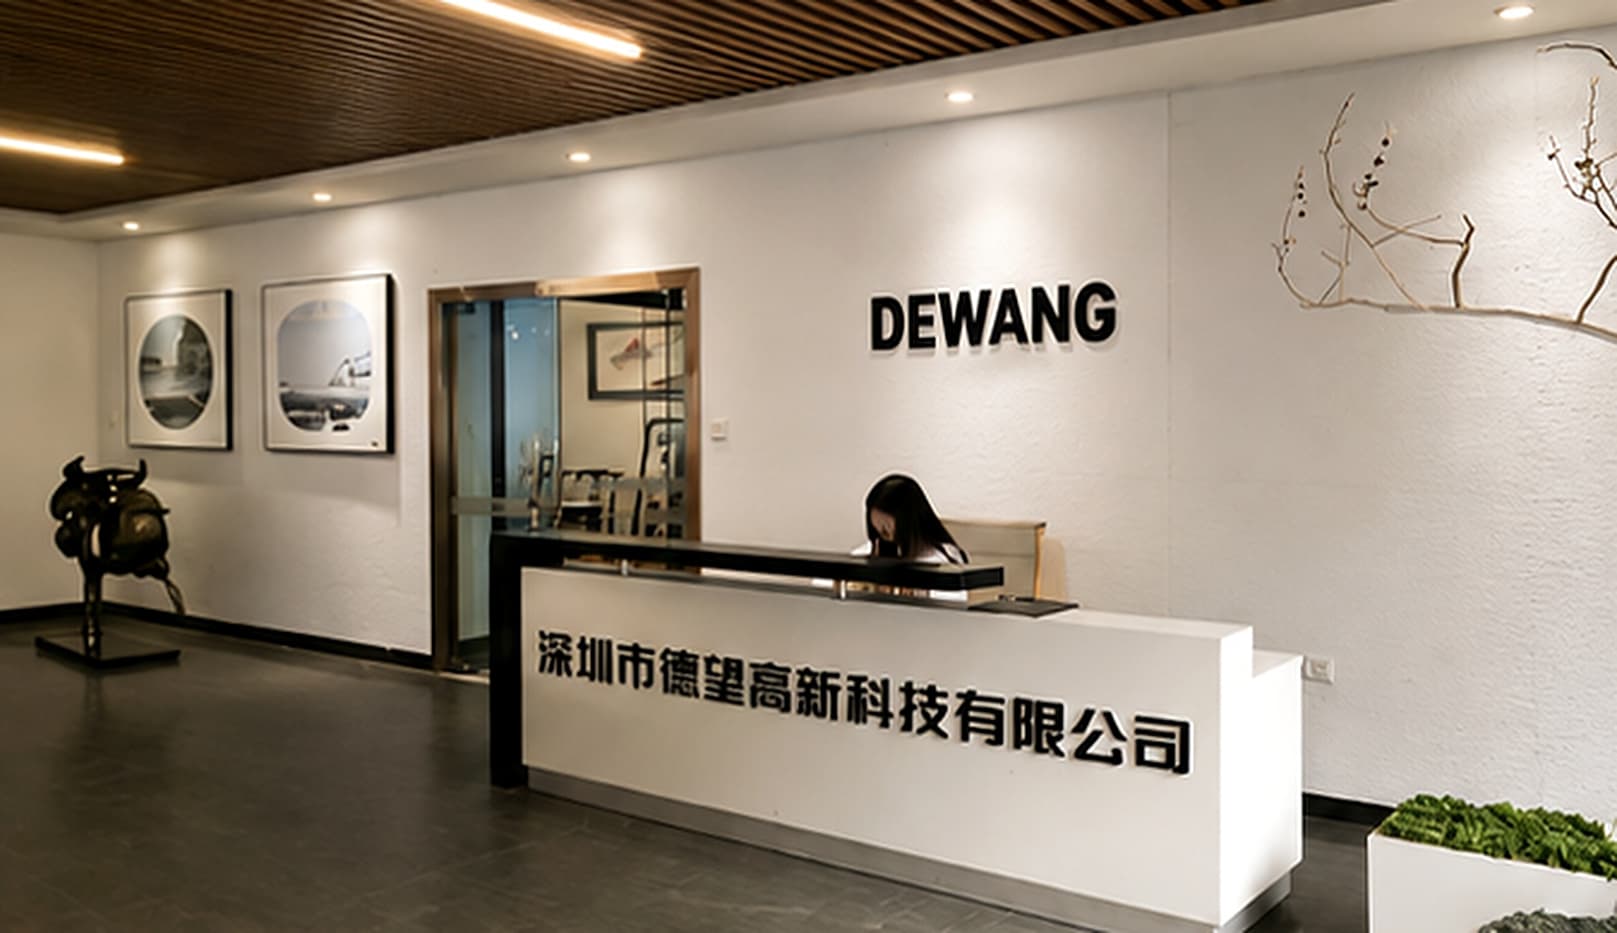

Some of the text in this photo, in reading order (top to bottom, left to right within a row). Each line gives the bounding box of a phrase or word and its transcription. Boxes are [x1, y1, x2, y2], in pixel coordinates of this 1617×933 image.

[871, 282, 1117, 351] DEWANG
[538, 630, 1191, 776] 深圳市德望高新科技有限公司
